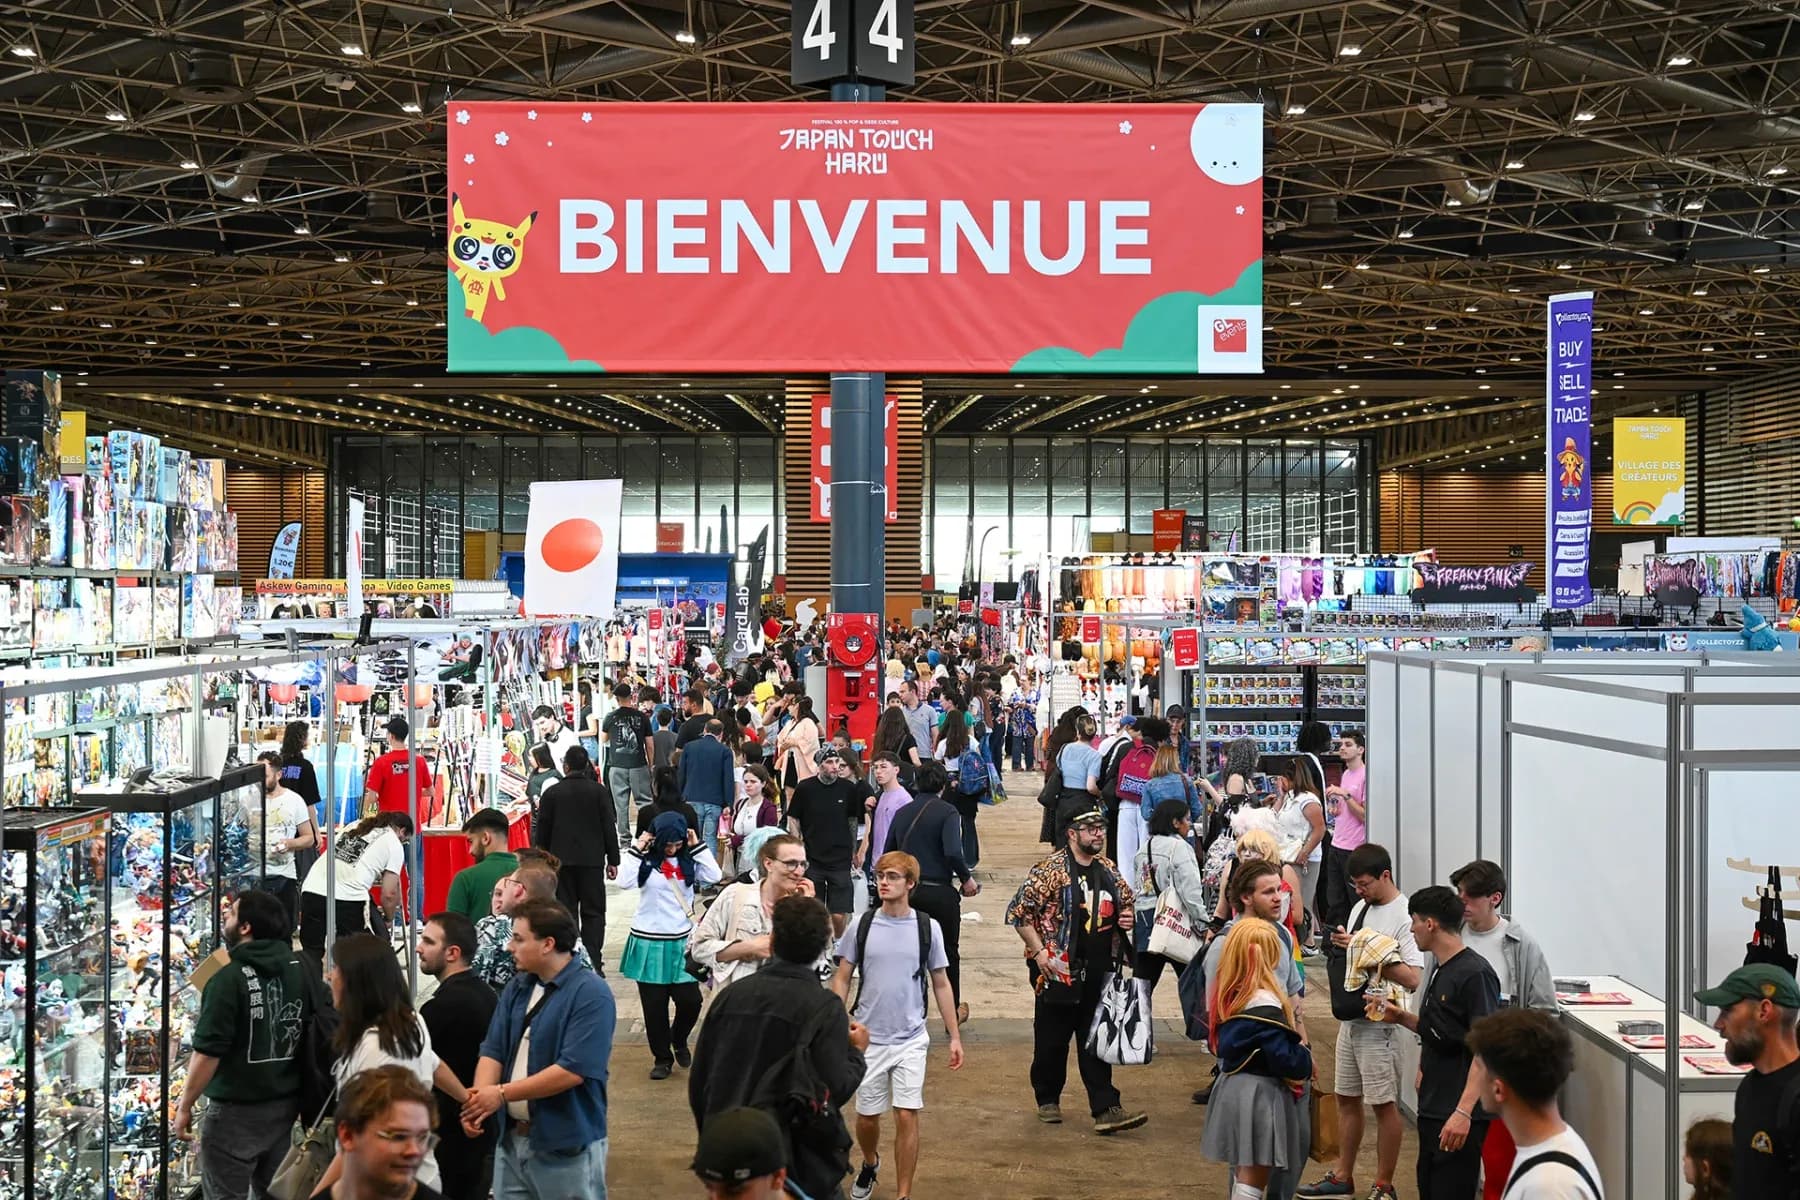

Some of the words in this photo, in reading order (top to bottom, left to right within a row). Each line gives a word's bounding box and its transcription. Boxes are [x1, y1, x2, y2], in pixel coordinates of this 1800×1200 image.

[802, 0, 836, 60] 4
[868, 0, 903, 64] 4
[779, 129, 854, 150] JAPAN
[859, 129, 933, 150] TOUCH
[825, 152, 887, 174] HARU
[559, 199, 1152, 276] BIENVENUE
[1214, 318, 1233, 333] GL
[1559, 341, 1583, 357] BUY
[1559, 374, 1585, 390] SELL
[1618, 461, 1659, 470] VILLAGE
[1662, 461, 1681, 470] DES
[1621, 470, 1678, 481] CRÉATEURS
[259, 581, 292, 592] Askew
[295, 581, 333, 593] Gaming
[387, 581, 414, 592] Video
[416, 581, 451, 592] Games
[1437, 567, 1481, 588] FREAKY
[1484, 566, 1515, 589] PINK
[733, 586, 750, 652] CardLab
[1167, 919, 1192, 939] AMOUR
